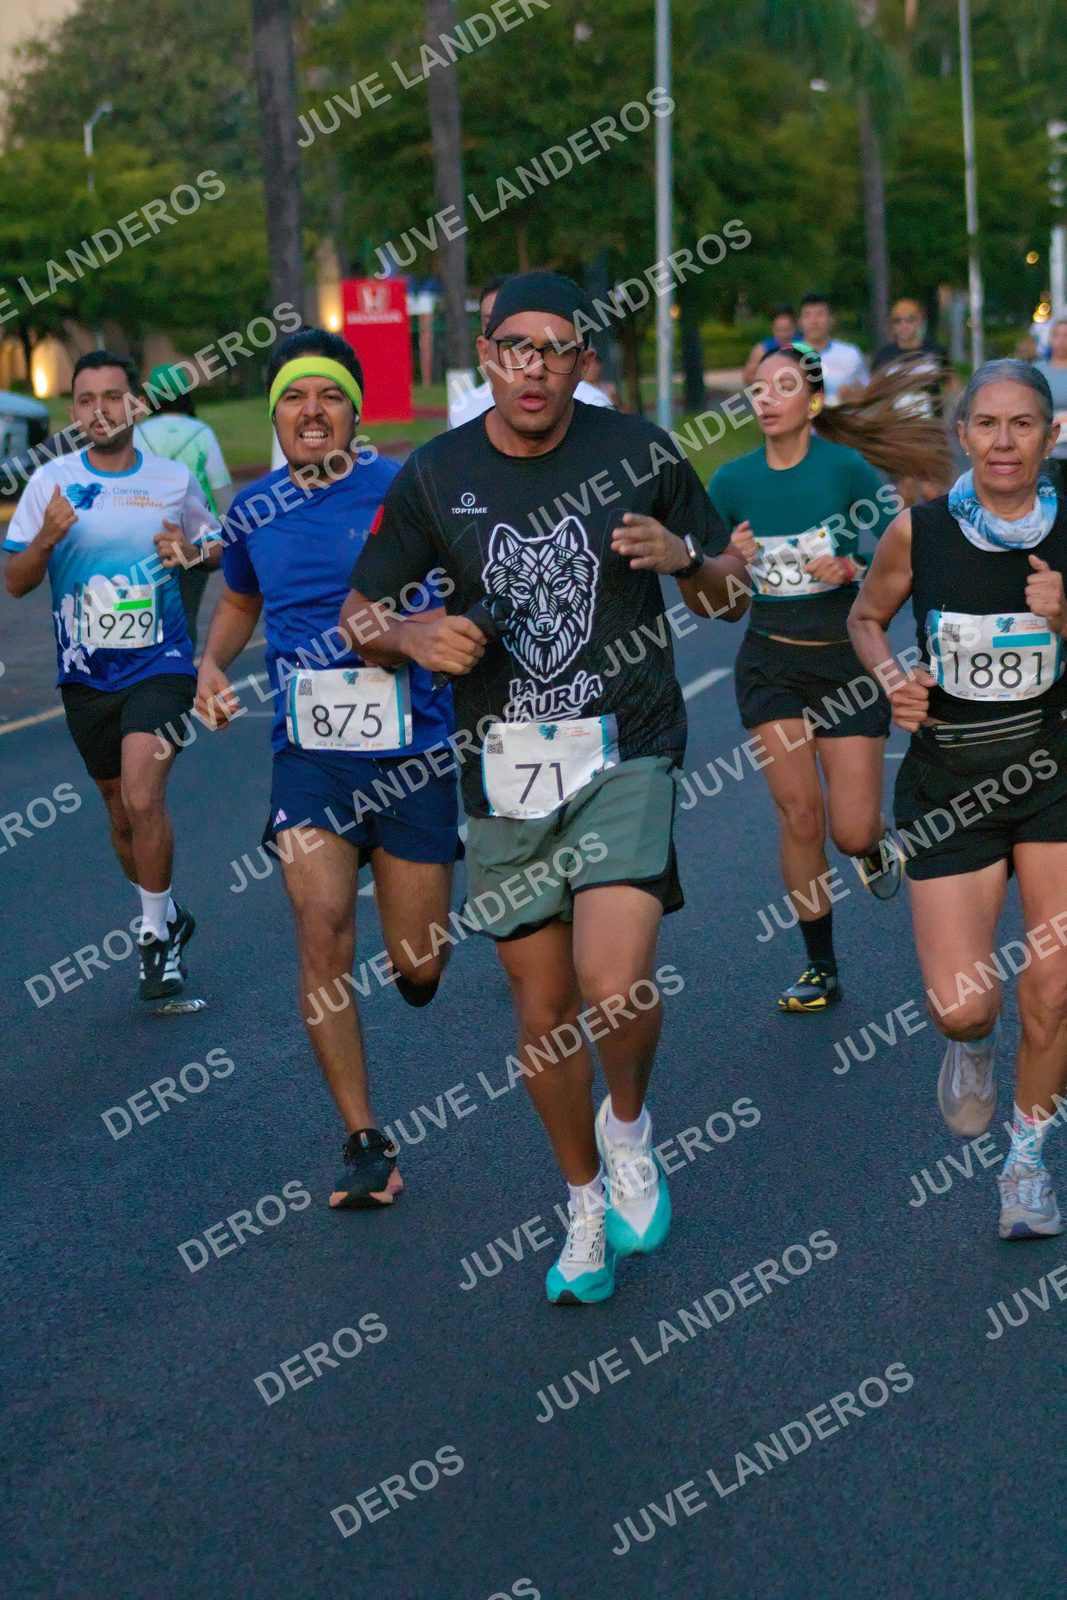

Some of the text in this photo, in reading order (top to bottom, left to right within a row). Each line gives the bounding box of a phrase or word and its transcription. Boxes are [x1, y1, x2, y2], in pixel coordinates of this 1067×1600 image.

[451, 507, 488, 515] TOPTIME
[764, 553, 823, 588] 63
[84, 611, 154, 640] 1929
[947, 651, 1043, 689] 1881
[509, 678, 537, 699] LA
[311, 703, 383, 739] 875
[514, 762, 564, 805] 71
